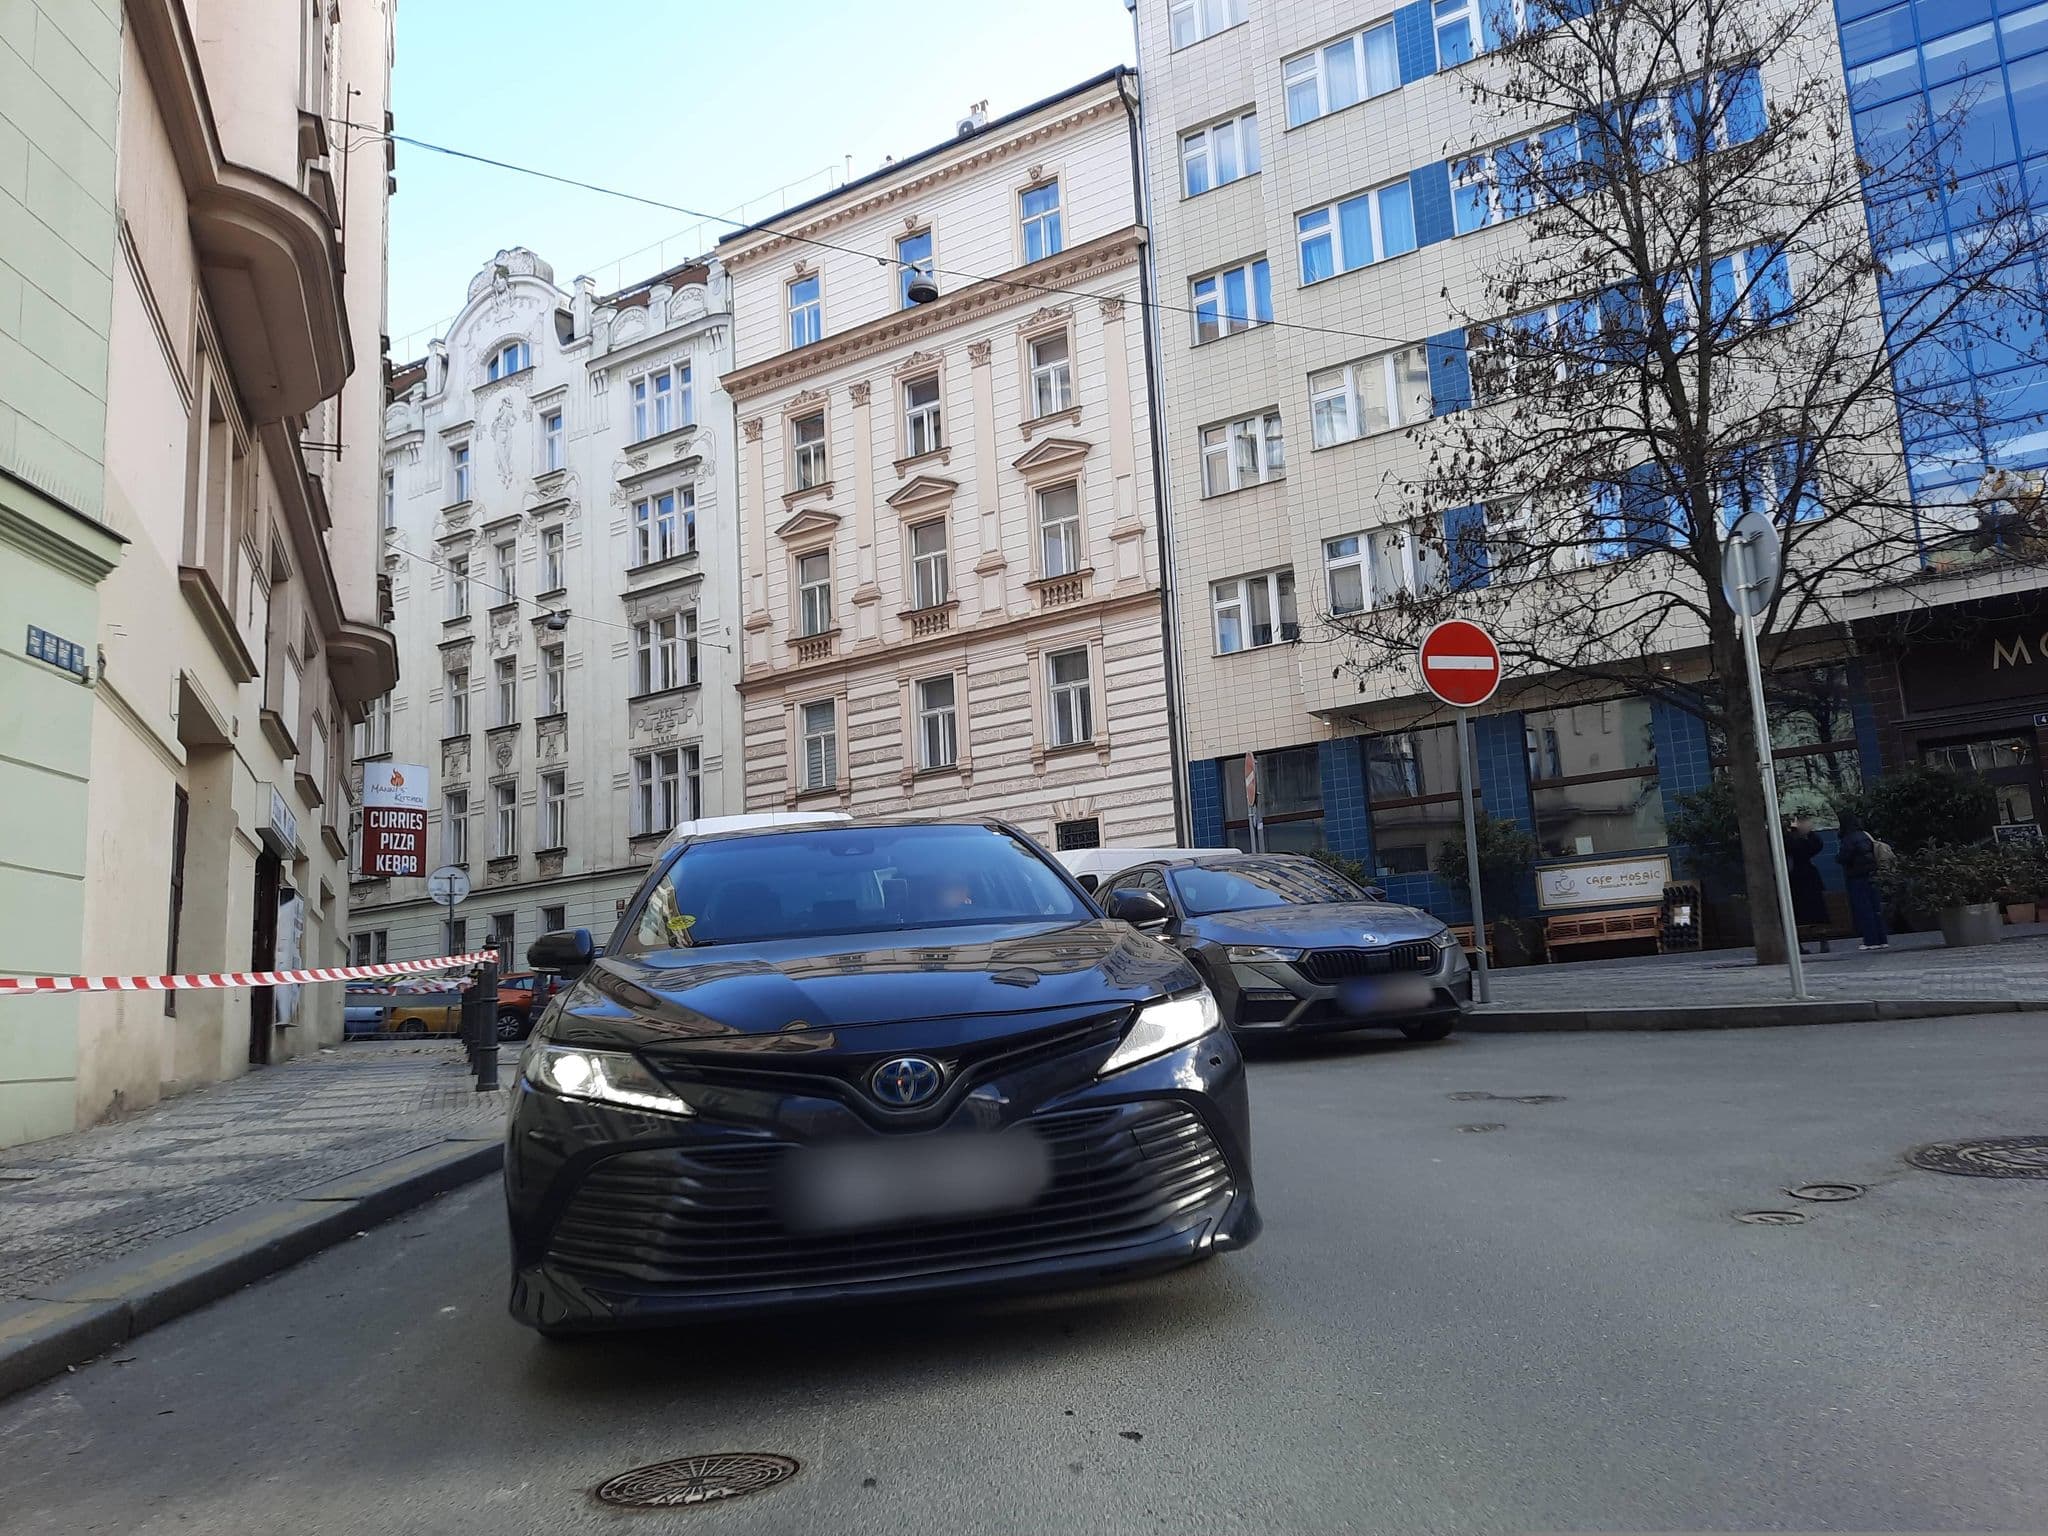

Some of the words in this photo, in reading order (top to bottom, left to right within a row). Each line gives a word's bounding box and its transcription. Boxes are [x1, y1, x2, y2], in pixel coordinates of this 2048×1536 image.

[1993, 632, 2048, 670] M
[370, 811, 423, 830] CURRIES
[380, 832, 415, 851] PIZZA
[376, 854, 418, 873] KEBAB
